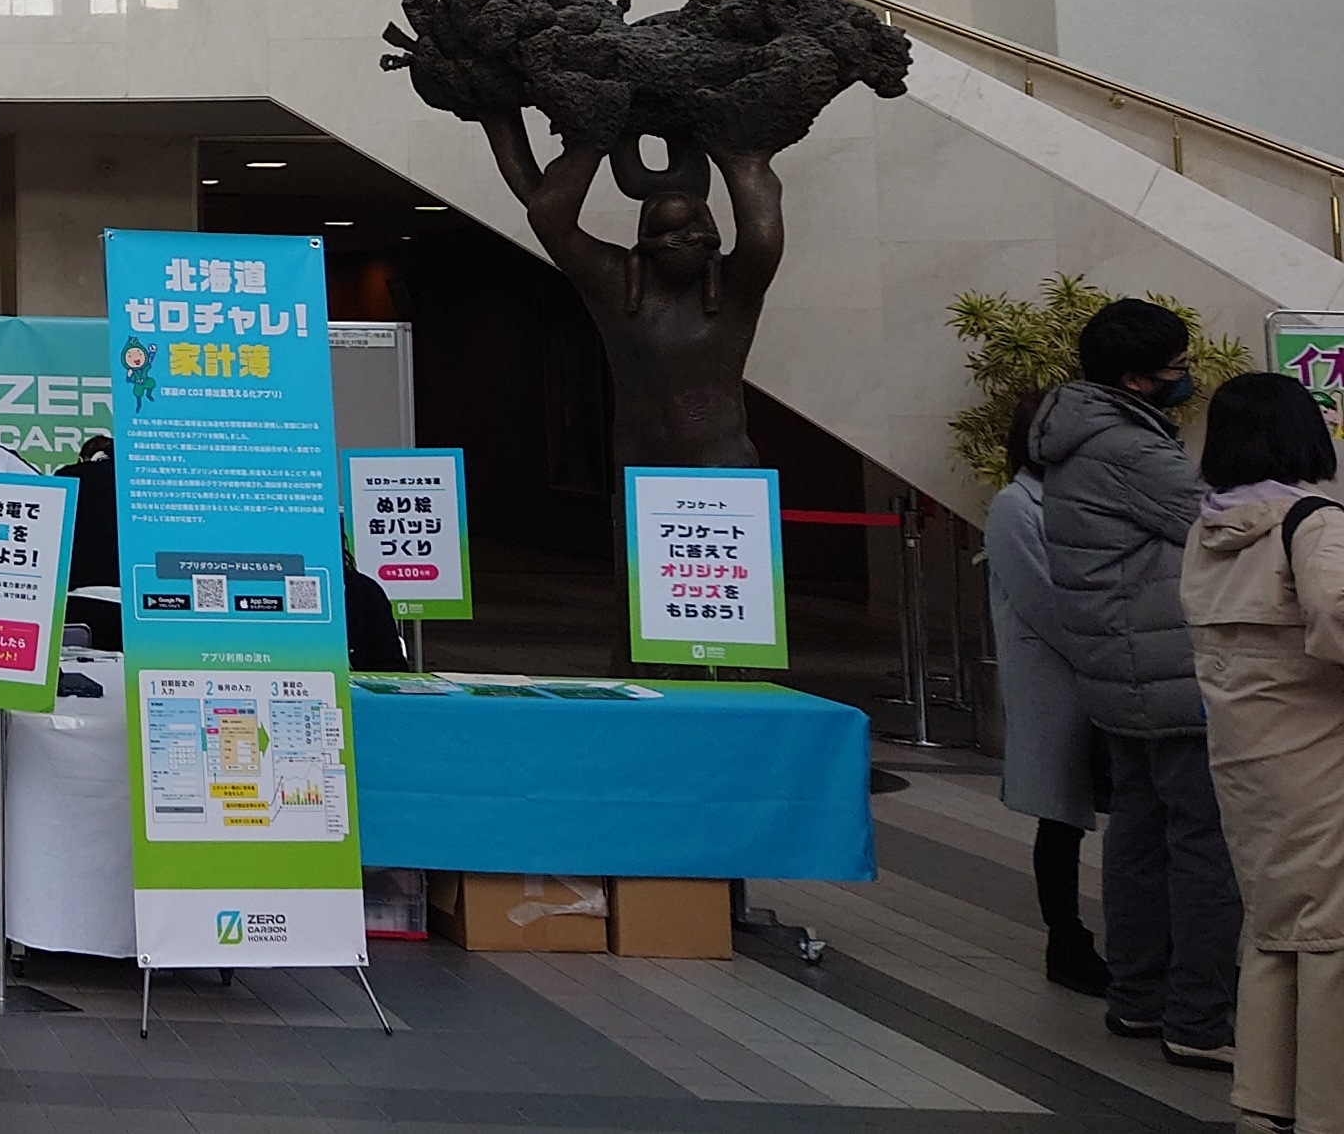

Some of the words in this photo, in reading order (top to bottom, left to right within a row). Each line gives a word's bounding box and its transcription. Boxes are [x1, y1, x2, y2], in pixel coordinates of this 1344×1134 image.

[165, 257, 267, 294] 北海道
[125, 297, 308, 338] ゼロチャレ!
[168, 342, 271, 378] 家計簿
[376, 496, 432, 514] ぬり絵
[676, 500, 727, 510] アンケート
[368, 518, 442, 535] 缶バッジ
[660, 524, 745, 540] アンケート
[381, 539, 432, 556] づくり
[669, 544, 738, 560] に答えて
[660, 563, 749, 580] オリジナル
[671, 582, 739, 600] グッズを
[175, 597, 186, 605] Play
[250, 598, 262, 606] App
[263, 598, 278, 606] Store
[666, 603, 745, 620] もらおう!
[201, 652, 272, 664] アプリ利用の流れ
[150, 681, 157, 695] 1
[161, 679, 195, 688] 初期設定の
[205, 680, 214, 696] 2
[217, 684, 252, 693] 毎月の入力
[271, 681, 279, 696] 3
[282, 681, 304, 689] 家庭の
[161, 688, 175, 696] 入力
[247, 914, 286, 925] ZERO
